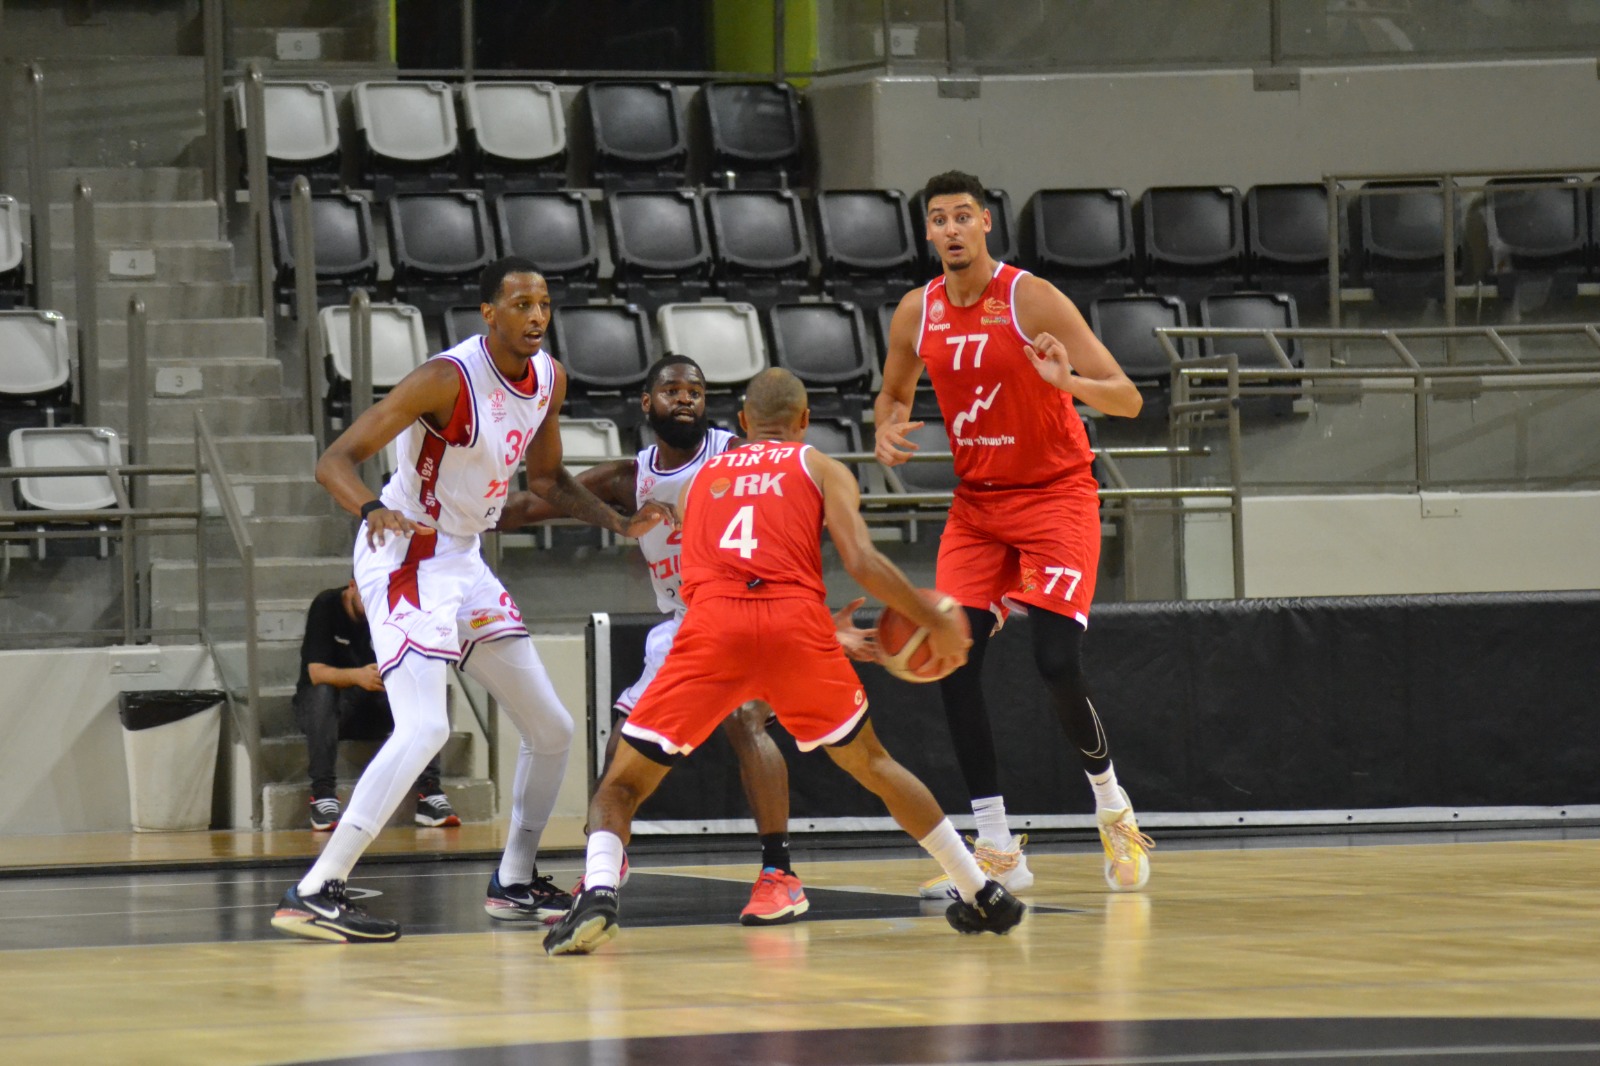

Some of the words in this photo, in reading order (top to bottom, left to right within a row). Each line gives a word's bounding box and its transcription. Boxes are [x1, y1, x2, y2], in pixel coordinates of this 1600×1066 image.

[128, 258, 137, 270] 4
[946, 334, 989, 371] 77
[175, 375, 184, 388] 3
[420, 456, 434, 482] 1924
[733, 472, 786, 497] RK
[719, 505, 758, 559] 4
[1044, 566, 1082, 602] 77
